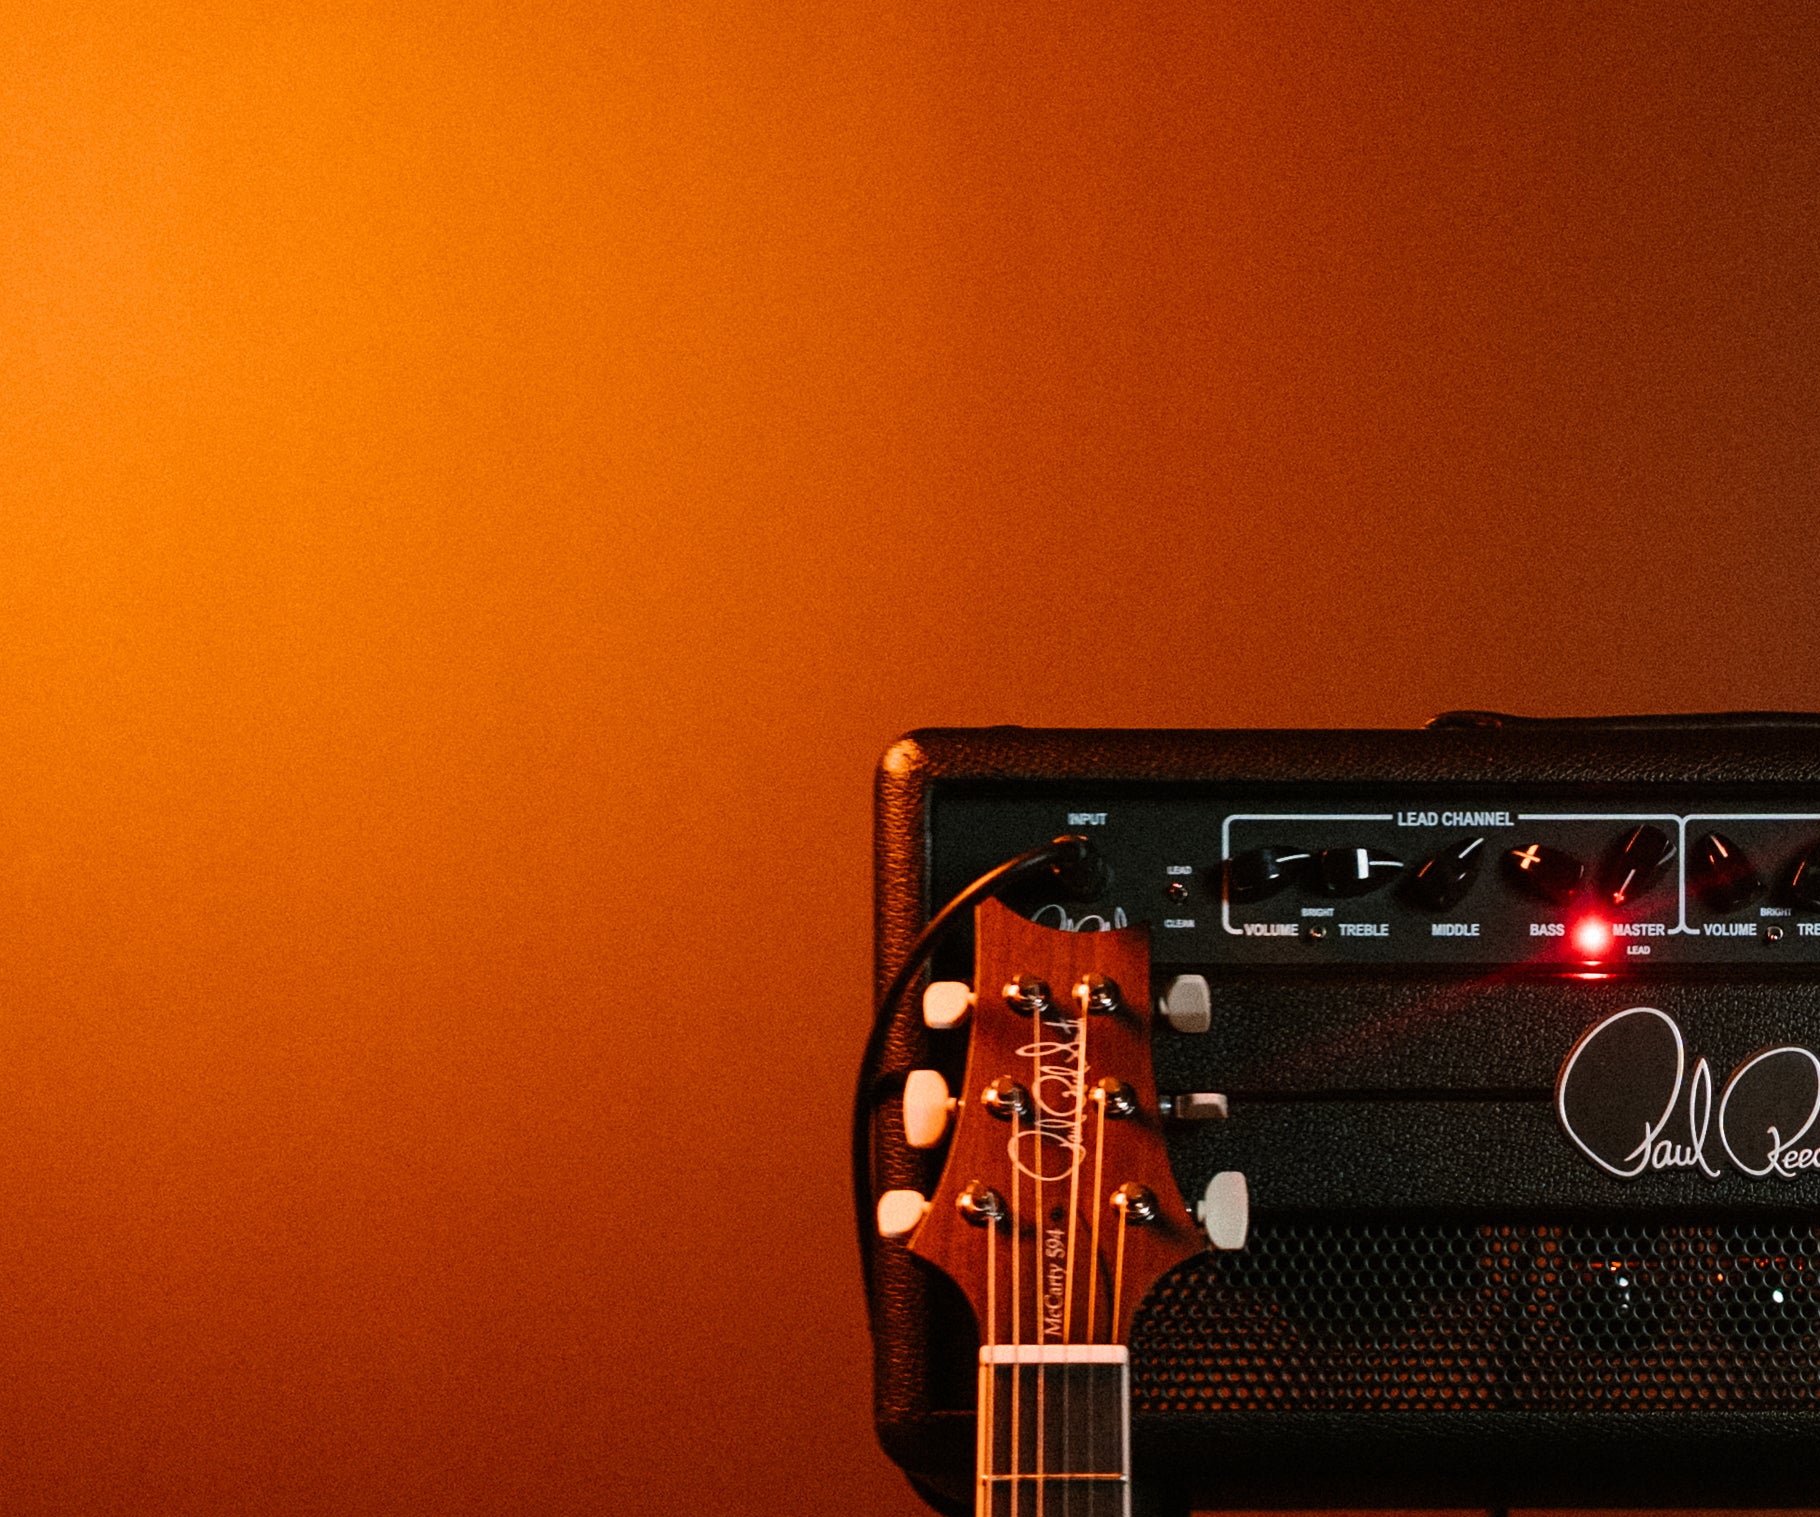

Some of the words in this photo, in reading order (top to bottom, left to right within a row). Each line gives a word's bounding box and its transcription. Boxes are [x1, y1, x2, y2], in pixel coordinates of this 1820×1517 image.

[1068, 813, 1107, 825] INPUT
[1398, 812, 1438, 826] LEAD
[1442, 812, 1514, 826] CHANNEL
[1760, 908, 1791, 916] BRIGHT
[1243, 923, 1300, 937] VOLUME
[1338, 924, 1389, 936] TREBLE
[1432, 923, 1480, 936] MIDDLE
[1529, 923, 1566, 937] BASS
[1613, 923, 1666, 937] MASTER
[1703, 923, 1757, 936] VOLUME
[1627, 945, 1651, 955] LEAD
[1559, 1006, 1721, 1179] Paul
[1044, 1263, 1067, 1337] McCarty
